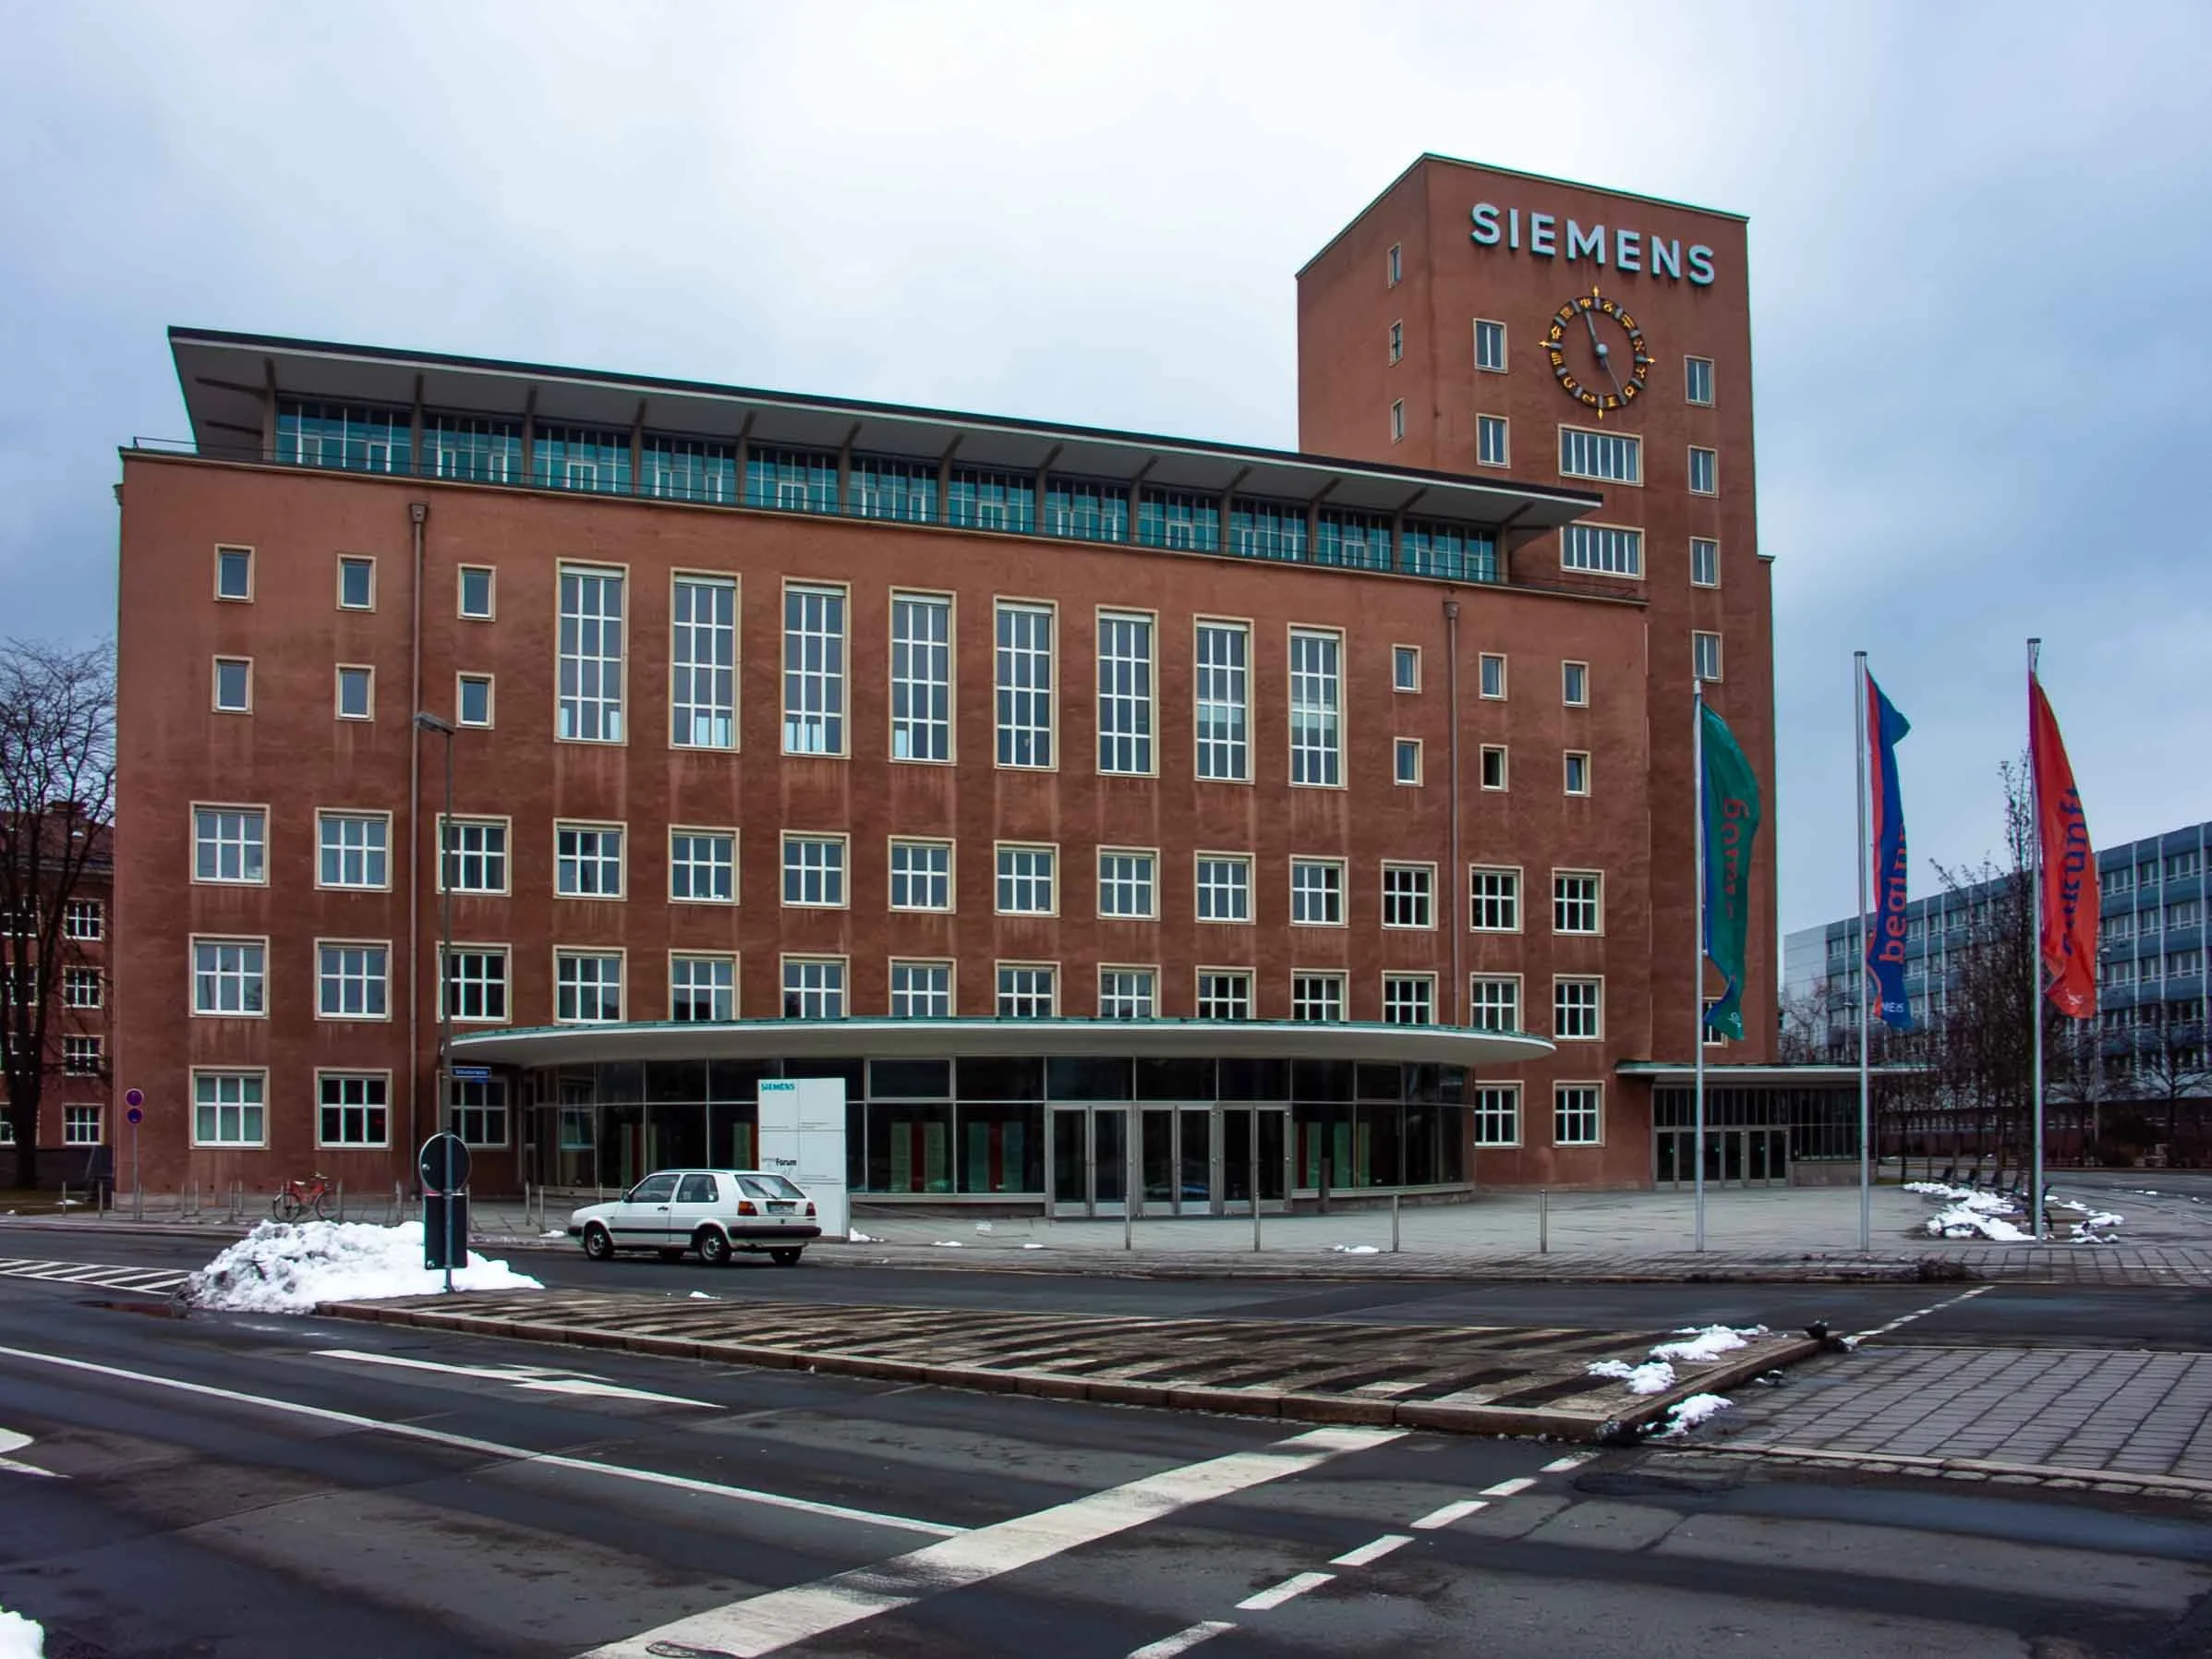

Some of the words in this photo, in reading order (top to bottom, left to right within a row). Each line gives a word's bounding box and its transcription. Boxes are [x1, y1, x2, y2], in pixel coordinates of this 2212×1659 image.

[1470, 202, 1716, 286] SIEMENS
[760, 1083, 796, 1091] SIEMENS
[776, 1157, 798, 1167] Forum
